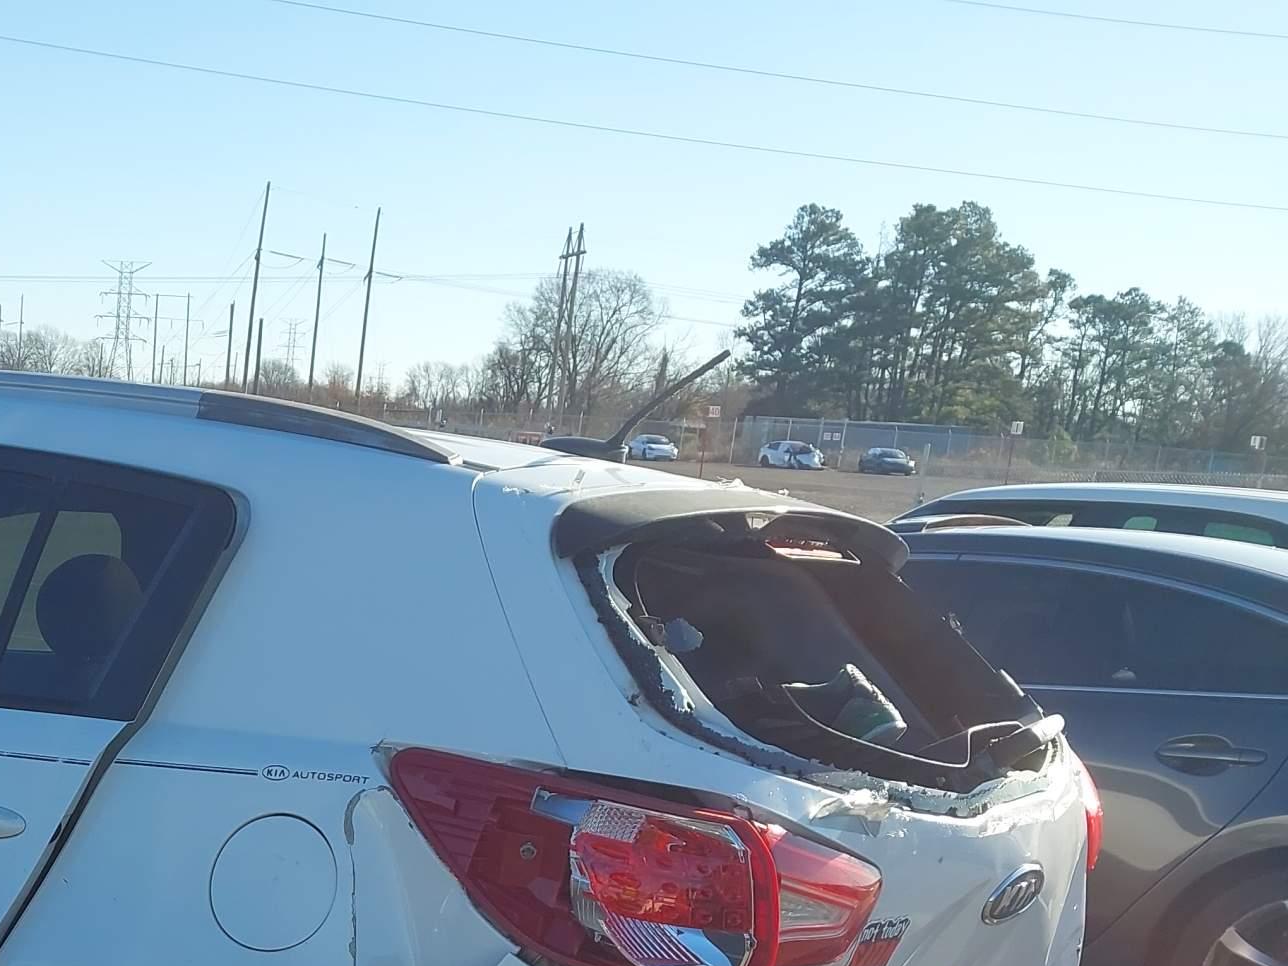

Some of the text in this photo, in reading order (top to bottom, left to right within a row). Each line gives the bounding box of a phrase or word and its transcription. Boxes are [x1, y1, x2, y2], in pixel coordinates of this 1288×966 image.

[265, 767, 370, 785] KIA AUTOSPORT
[861, 921, 908, 942] not today
